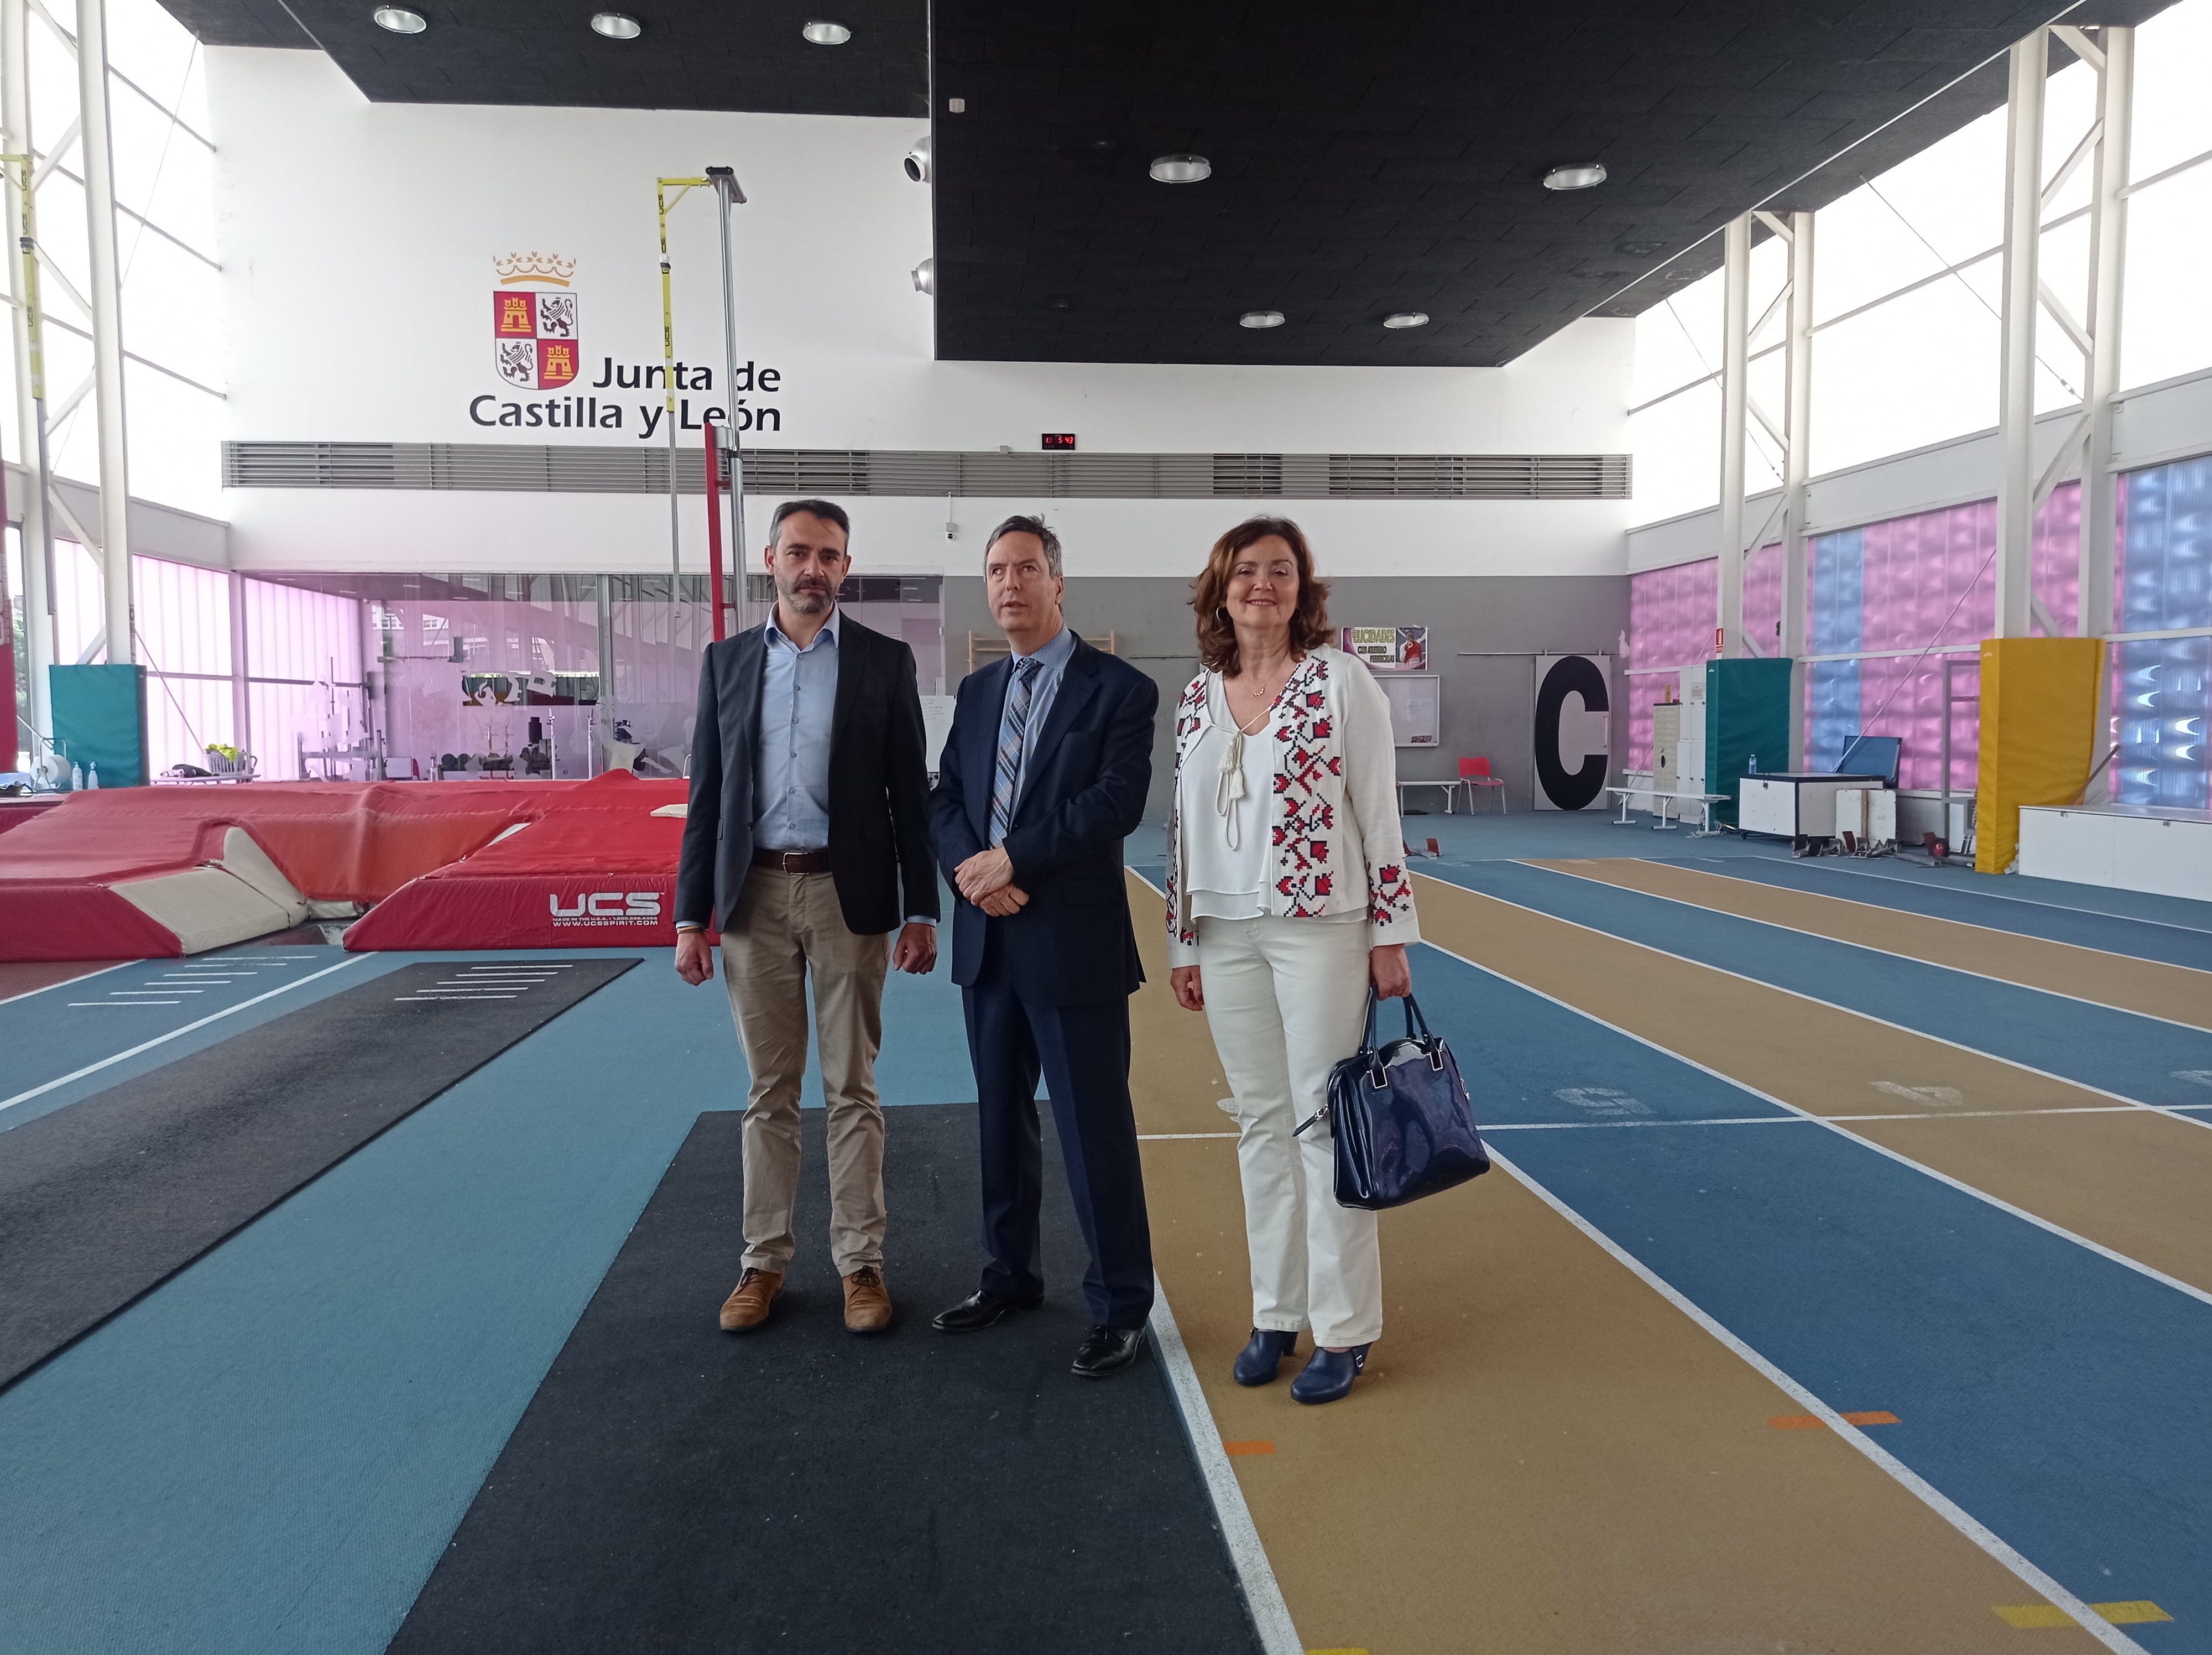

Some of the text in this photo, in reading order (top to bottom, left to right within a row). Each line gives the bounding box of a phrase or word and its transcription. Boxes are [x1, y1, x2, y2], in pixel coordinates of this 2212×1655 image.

[592, 357, 781, 392] Junta de
[469, 394, 781, 439] Castilla y León
[1350, 629, 1395, 643] FELICIDADES
[1535, 655, 1609, 810] C
[549, 892, 661, 917] UCS
